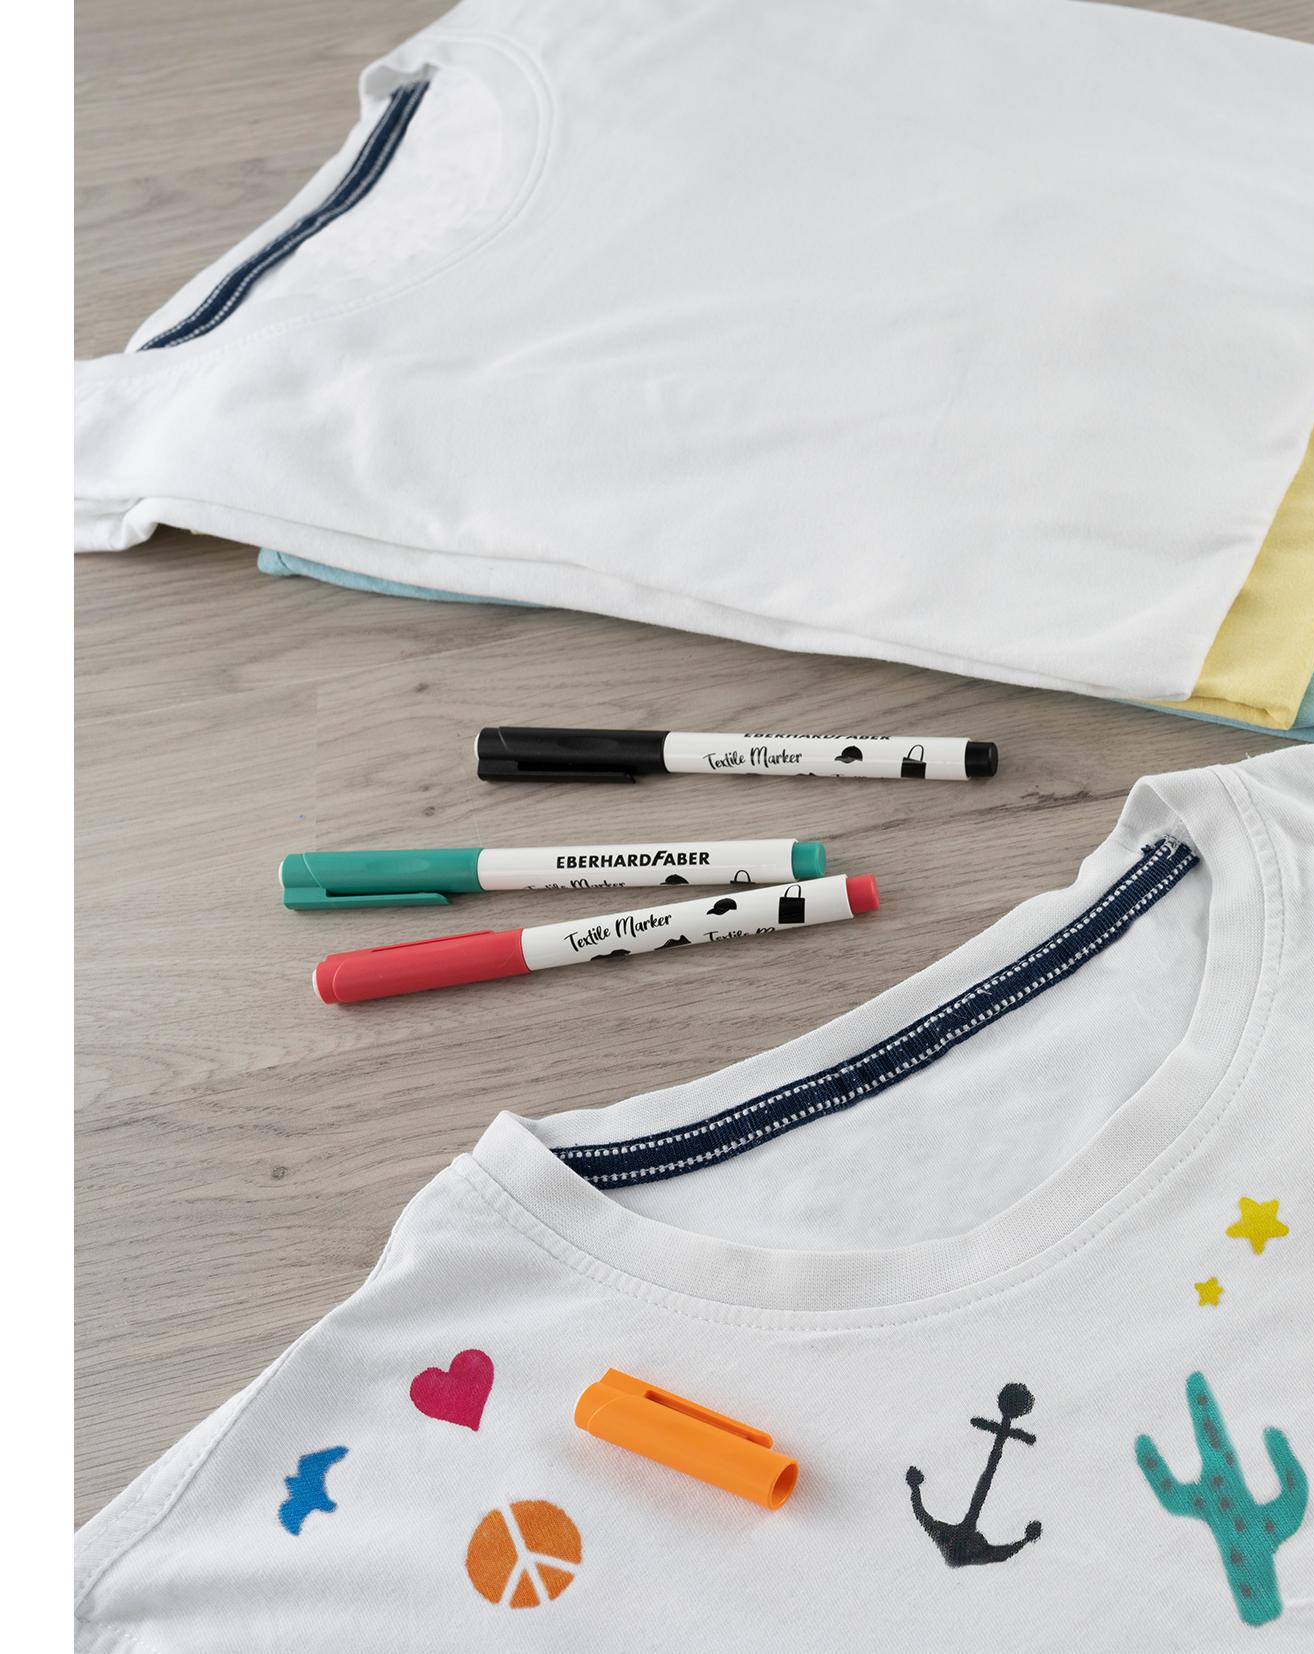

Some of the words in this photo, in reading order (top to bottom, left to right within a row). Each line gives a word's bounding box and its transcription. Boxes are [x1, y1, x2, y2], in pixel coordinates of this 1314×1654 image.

[703, 752, 746, 770] Textile
[750, 745, 803, 767] Marker
[556, 850, 711, 870] EBERHARDFABER
[563, 925, 611, 952] Textile
[615, 912, 672, 938] Marker
